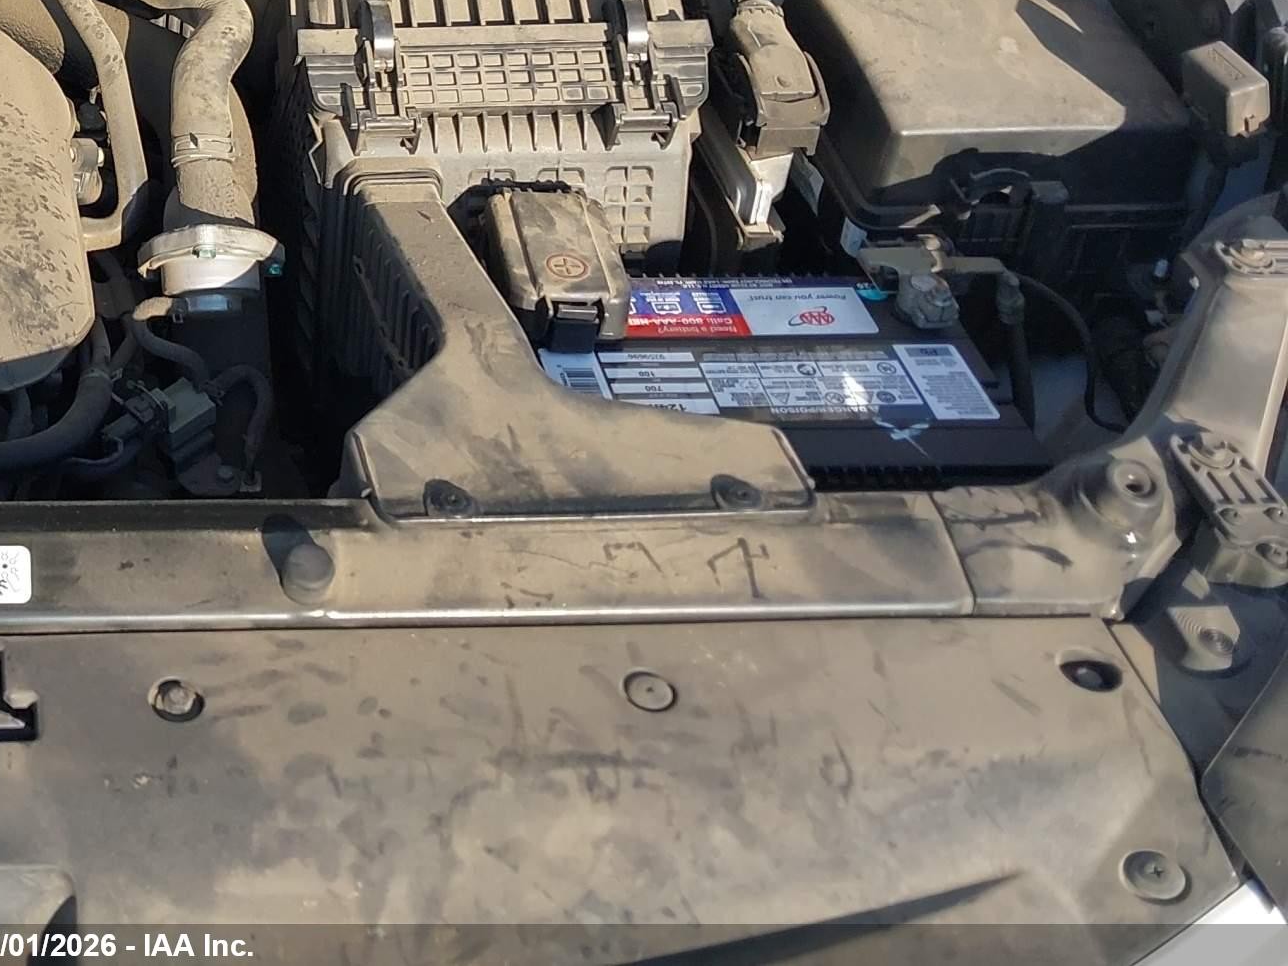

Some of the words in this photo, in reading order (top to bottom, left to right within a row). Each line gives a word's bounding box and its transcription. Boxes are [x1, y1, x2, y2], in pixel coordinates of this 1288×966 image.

[794, 293, 812, 301] you
[705, 317, 733, 325] Call:
[799, 311, 833, 326] AAA
[657, 325, 699, 334] battery?
[710, 325, 738, 334] Need
